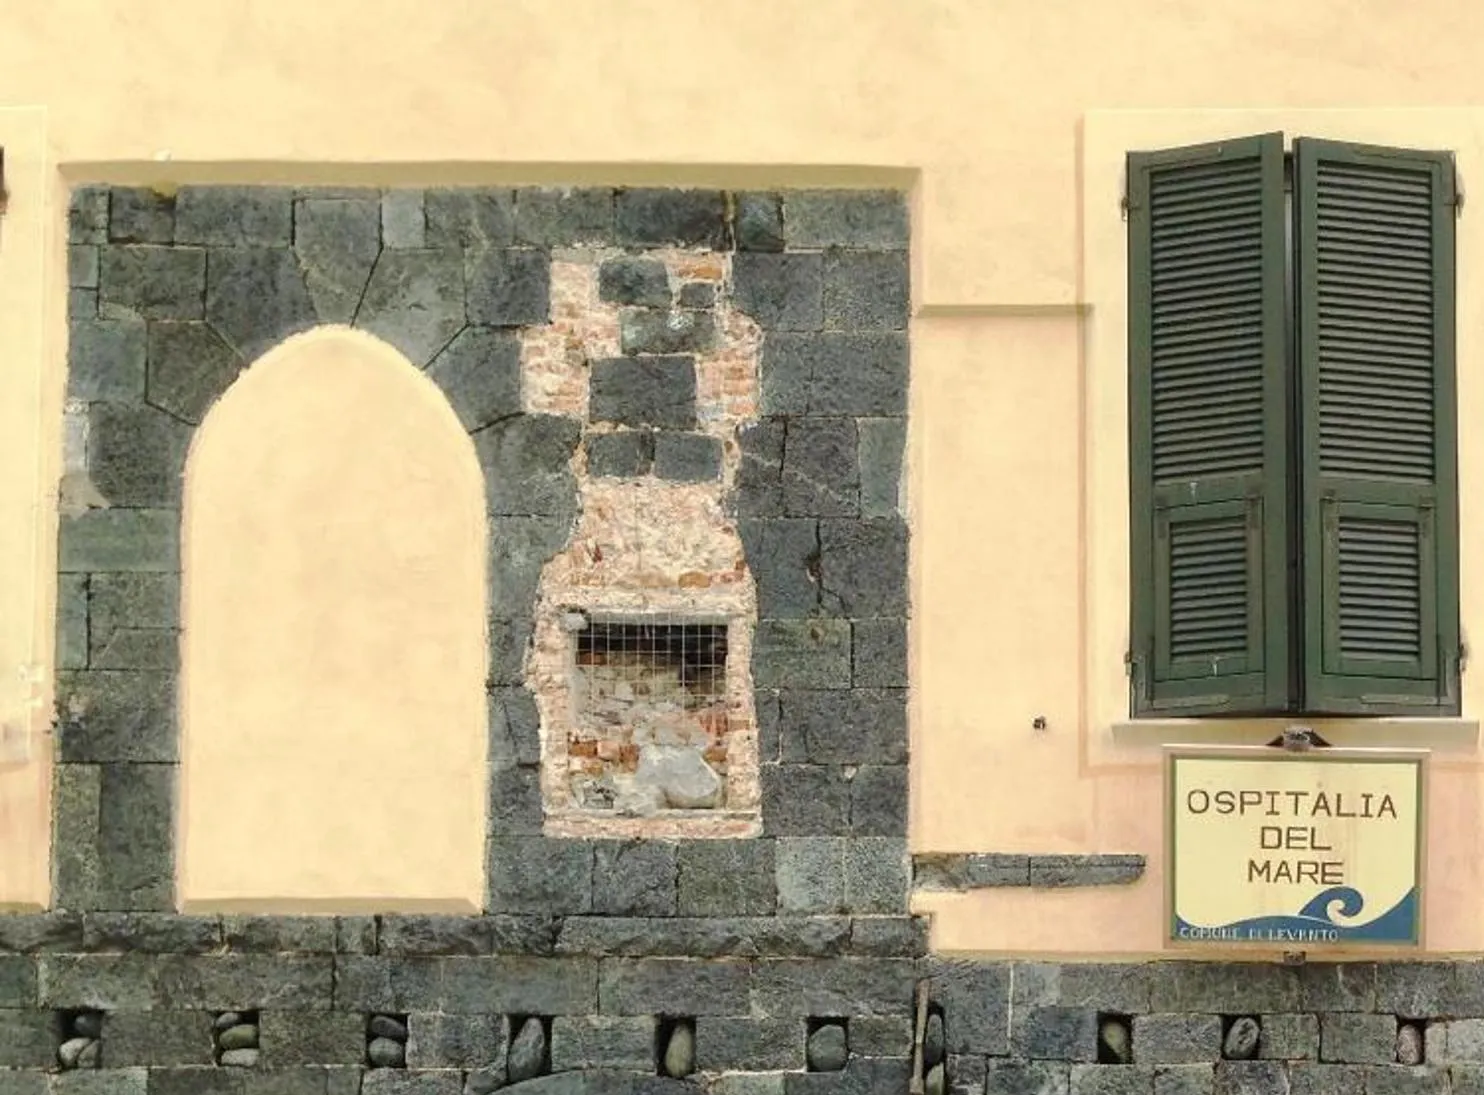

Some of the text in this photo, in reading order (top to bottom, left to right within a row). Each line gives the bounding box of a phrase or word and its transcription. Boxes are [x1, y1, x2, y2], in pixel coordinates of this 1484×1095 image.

[1187, 789, 1397, 819] OSPITALIA
[1260, 826, 1332, 851] DEL
[1248, 859, 1344, 885] MARE
